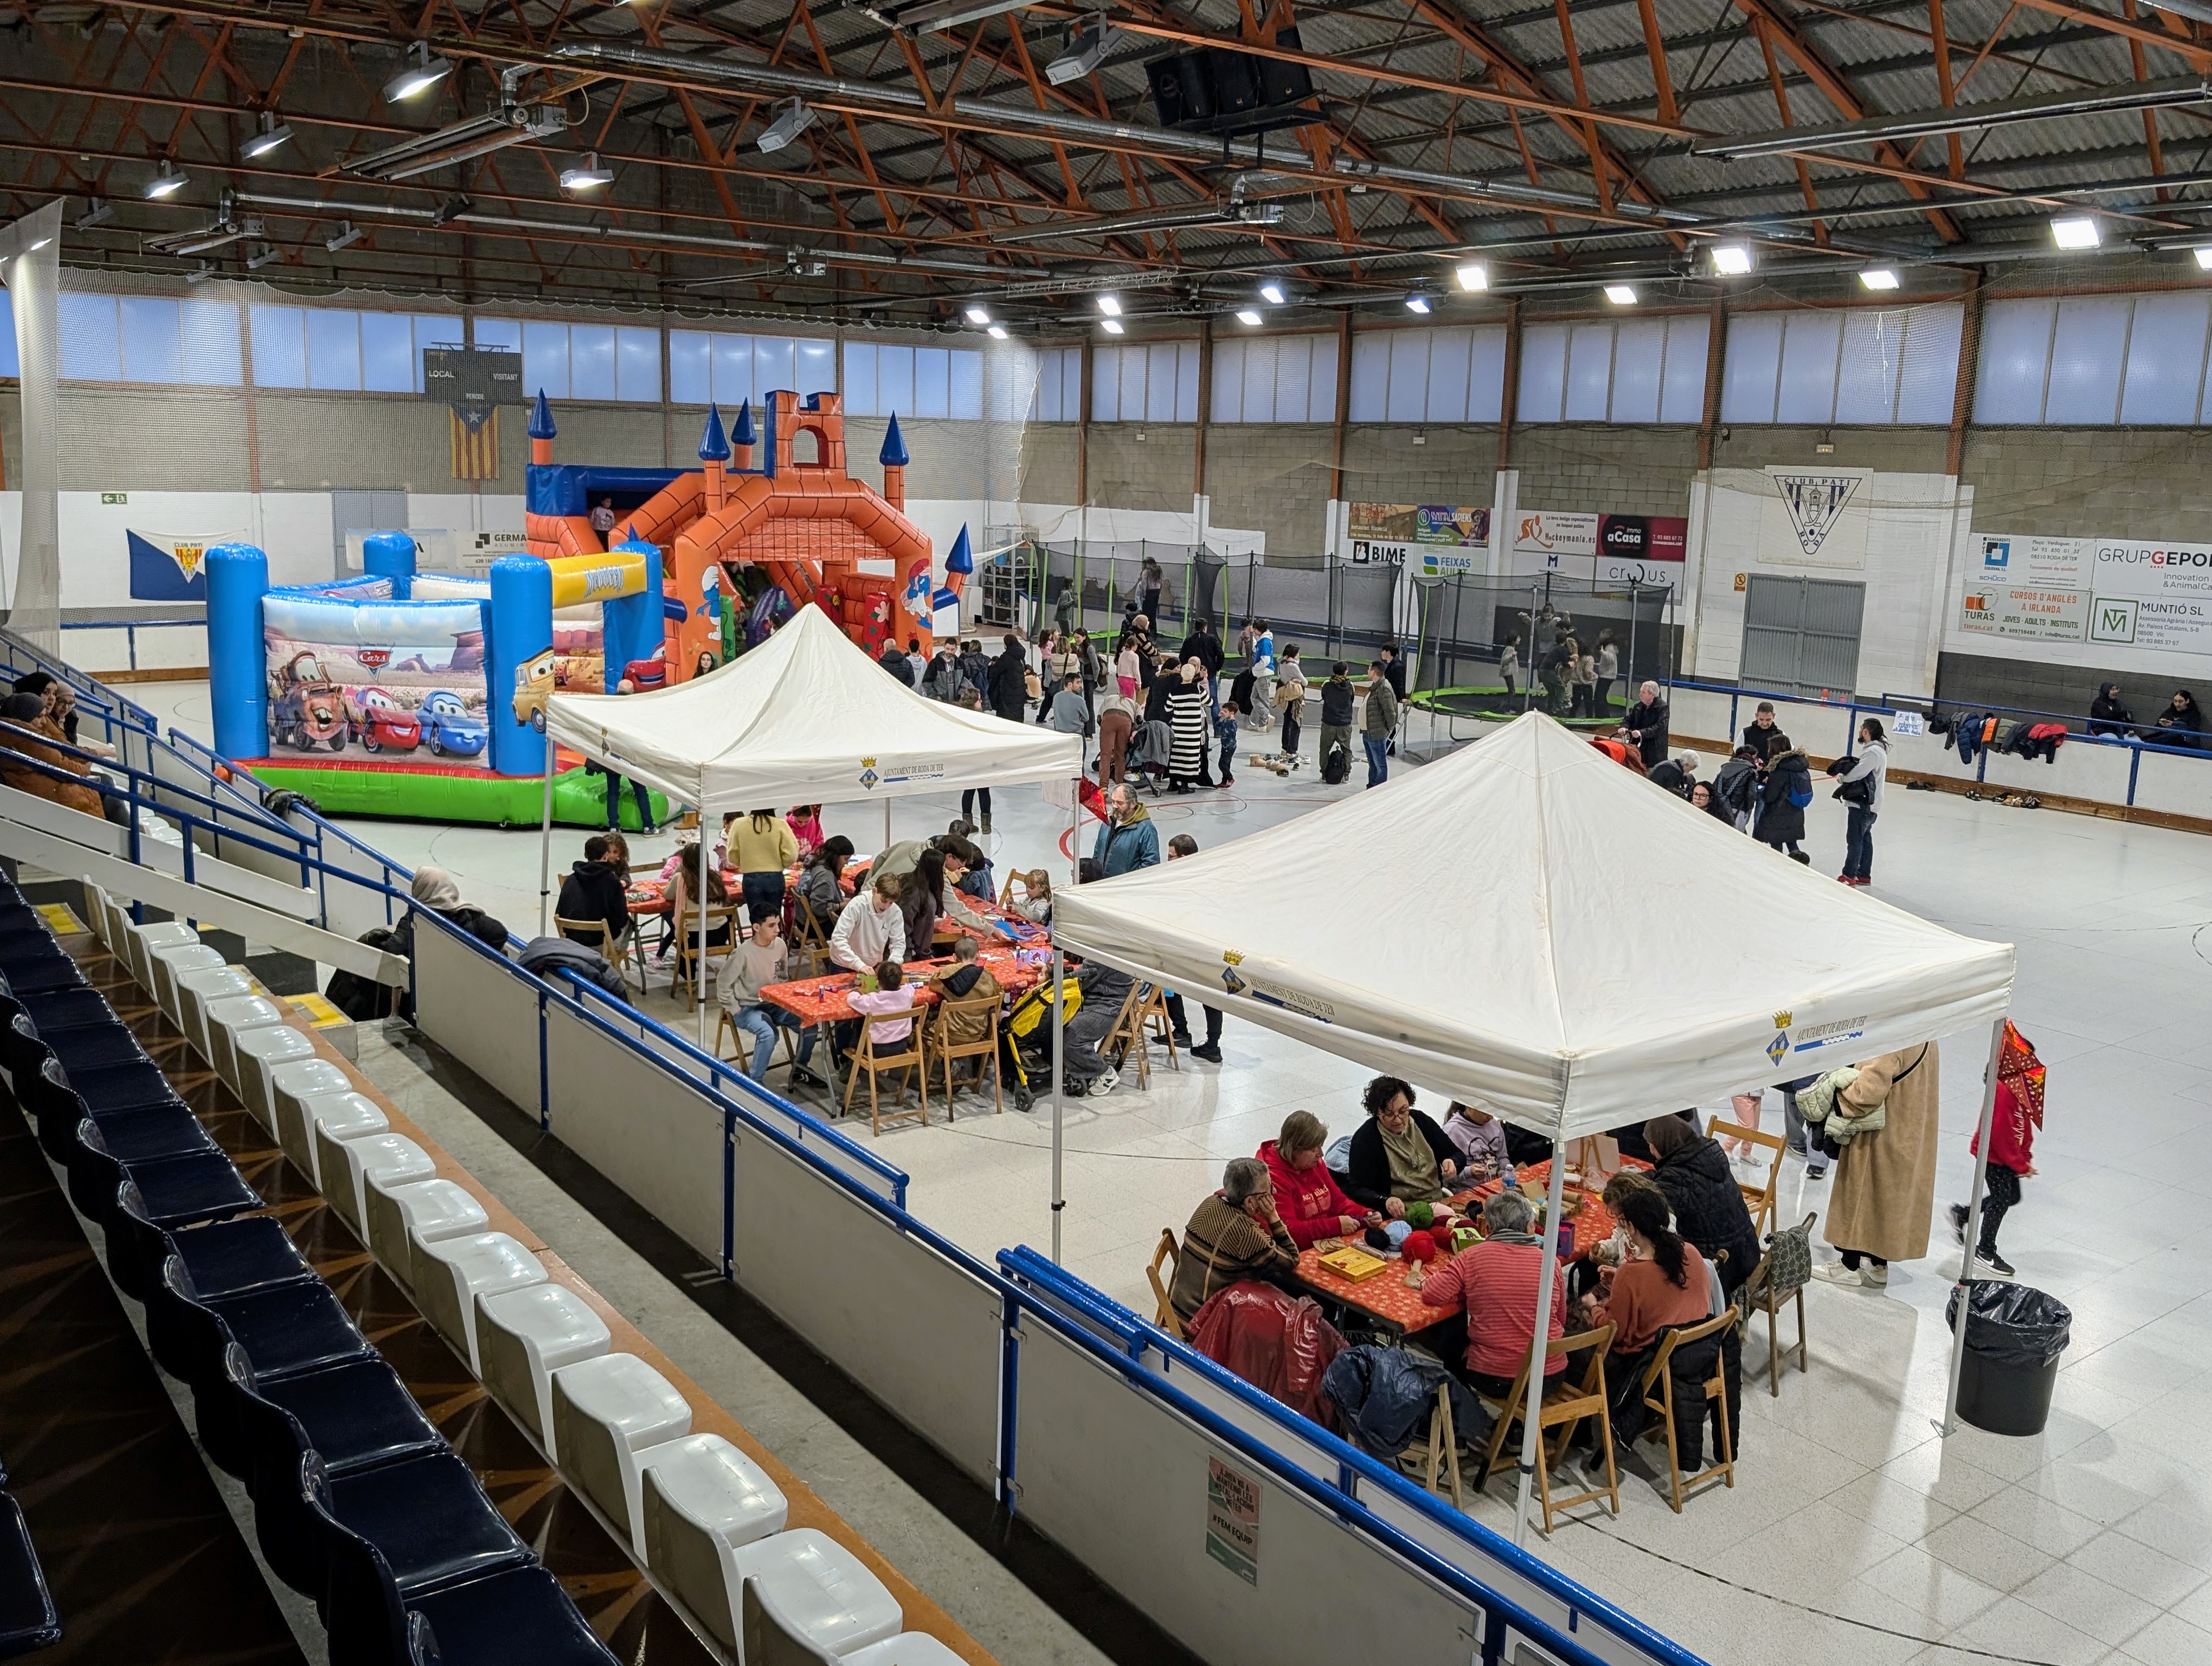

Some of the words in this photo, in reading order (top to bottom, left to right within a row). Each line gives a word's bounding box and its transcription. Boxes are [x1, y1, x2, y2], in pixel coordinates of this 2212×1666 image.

[1545, 533, 1596, 543] Hockeymania.es
[1607, 531, 1641, 543] aCasa
[1372, 547, 1406, 562] BIME
[2099, 548, 2212, 567] GRUPGEPO
[1441, 557, 1471, 568] FEIXAS
[1547, 555, 1559, 567] M
[2164, 573, 2209, 582] Innovation
[2170, 581, 2200, 589] Animal
[2010, 591, 2037, 600] CURSOS
[2039, 593, 2077, 604] D'ANGLÈS
[2021, 603, 2027, 611] A
[2028, 604, 2061, 614] IRLANDA
[2141, 603, 2187, 614] MUNTIÓ
[2189, 606, 2204, 616] SL
[1965, 611, 1995, 621] TURAS
[2003, 615, 2021, 624] JOVES
[2024, 617, 2046, 626] ADULTS
[2050, 619, 2079, 629] INSTITUTS
[1964, 623, 1993, 631] turas.cat
[2044, 631, 2080, 639] info@turas.cat
[360, 651, 387, 662] Cars
[884, 766, 911, 778] AJUNTAMENT
[918, 765, 929, 773] RODA
[1250, 978, 1287, 998] AJUNTAMENT
[1287, 990, 1296, 1002] DE
[1295, 992, 1314, 1008] RODA
[1313, 999, 1323, 1011] DE
[1321, 1003, 1335, 1016] TER
[1796, 1023, 1830, 1043] AJUNTAMENT
[1828, 1022, 1837, 1034] DE
[1835, 1019, 1851, 1031] RODA
[1849, 1017, 1859, 1029] DE
[1856, 1015, 1867, 1028] TER
[1245, 1484, 1250, 1493] A
[1243, 1490, 1252, 1503] LES
[1213, 1514, 1231, 1533] #FEM
[1232, 1527, 1252, 1545] EQUIP
